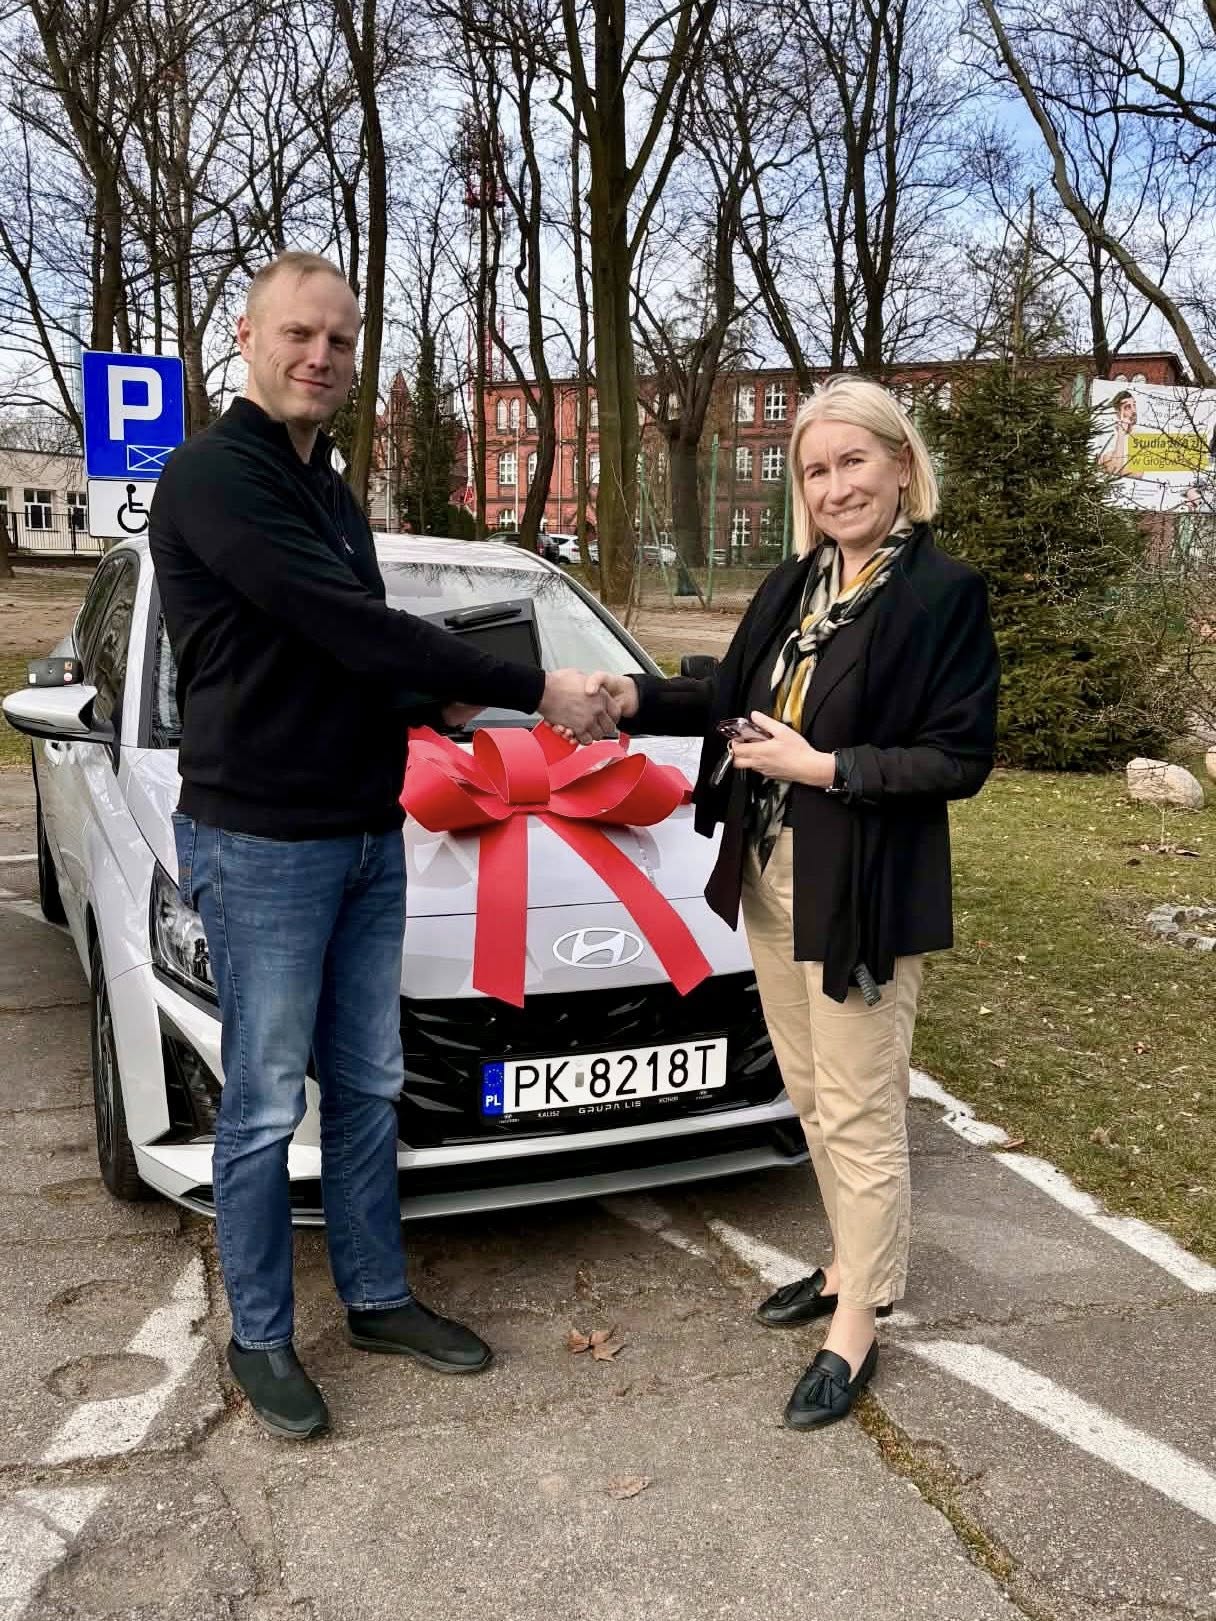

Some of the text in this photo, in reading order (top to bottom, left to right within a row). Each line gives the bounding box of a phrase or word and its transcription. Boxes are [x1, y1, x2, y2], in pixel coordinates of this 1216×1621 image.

[108, 364, 163, 441] P
[1132, 438, 1166, 449] Studia
[514, 1044, 717, 1108] PK 8218T
[485, 1094, 502, 1108] PL
[578, 1100, 642, 1114] GRUPA LIS
